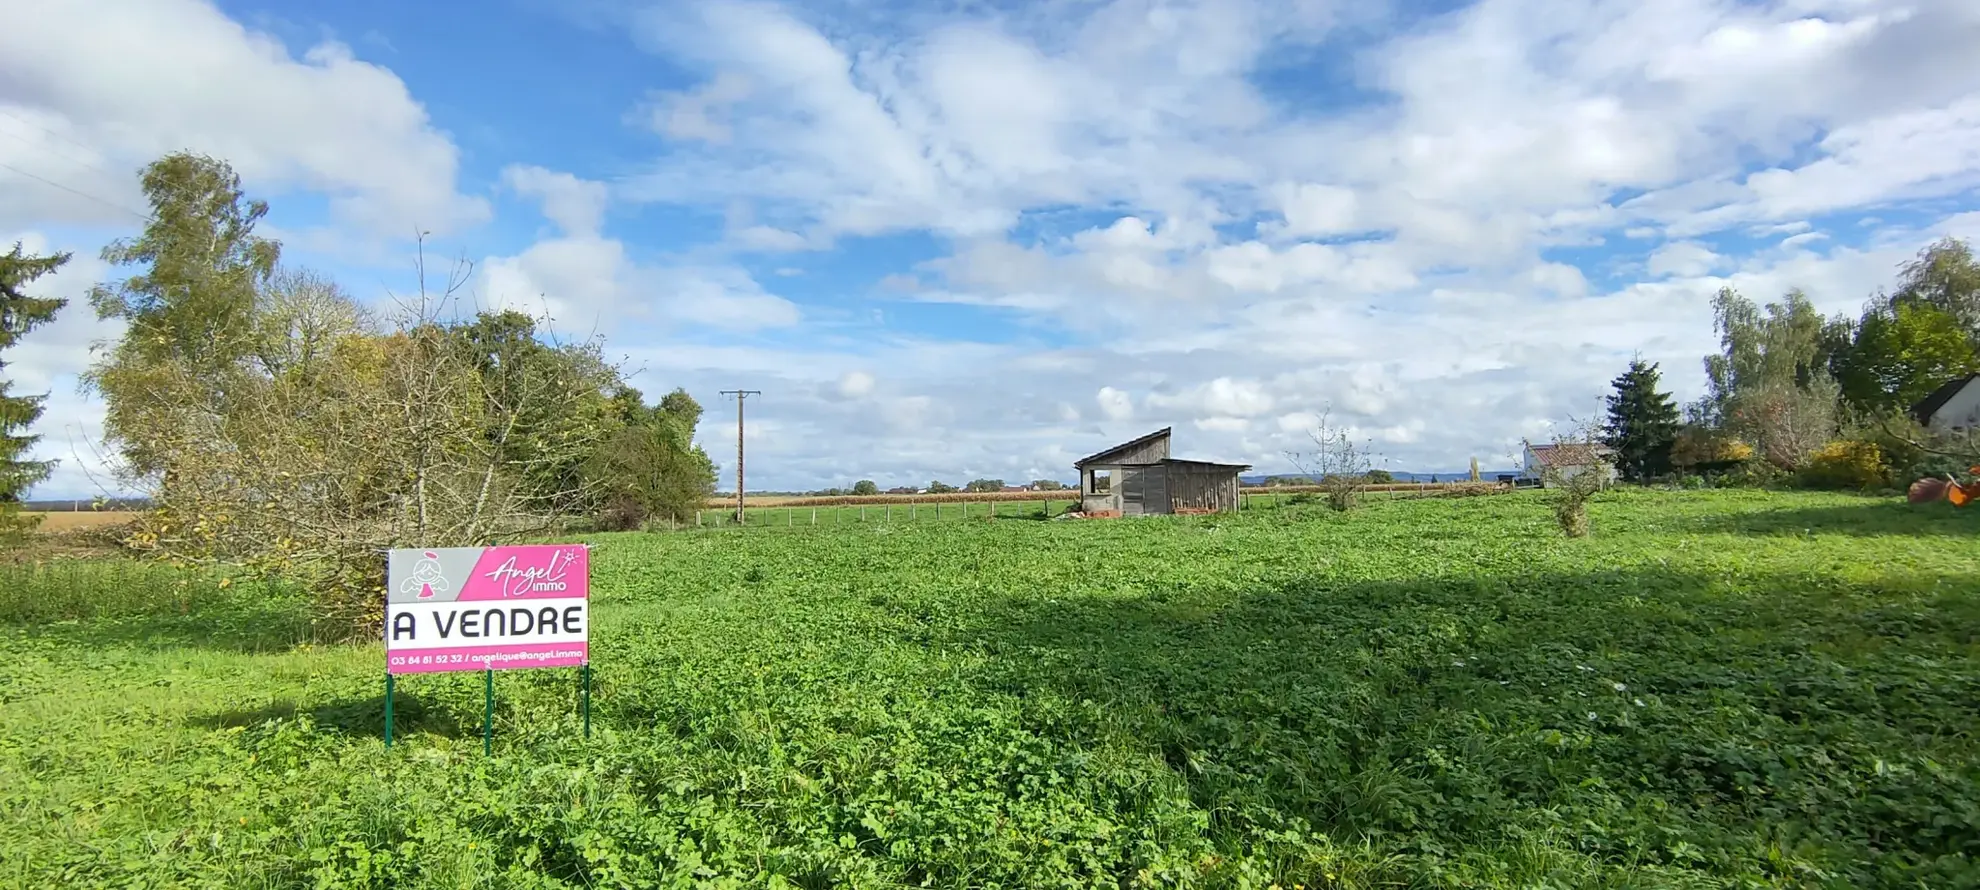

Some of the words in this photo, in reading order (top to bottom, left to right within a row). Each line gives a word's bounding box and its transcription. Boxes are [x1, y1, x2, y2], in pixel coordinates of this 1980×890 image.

[485, 550, 566, 597] Angel
[393, 611, 416, 640] A
[432, 606, 582, 639] VENDRE
[391, 656, 405, 665] 03
[435, 654, 448, 663] 52
[450, 653, 462, 663] 32
[471, 650, 583, 662] angelique@angel.immo
